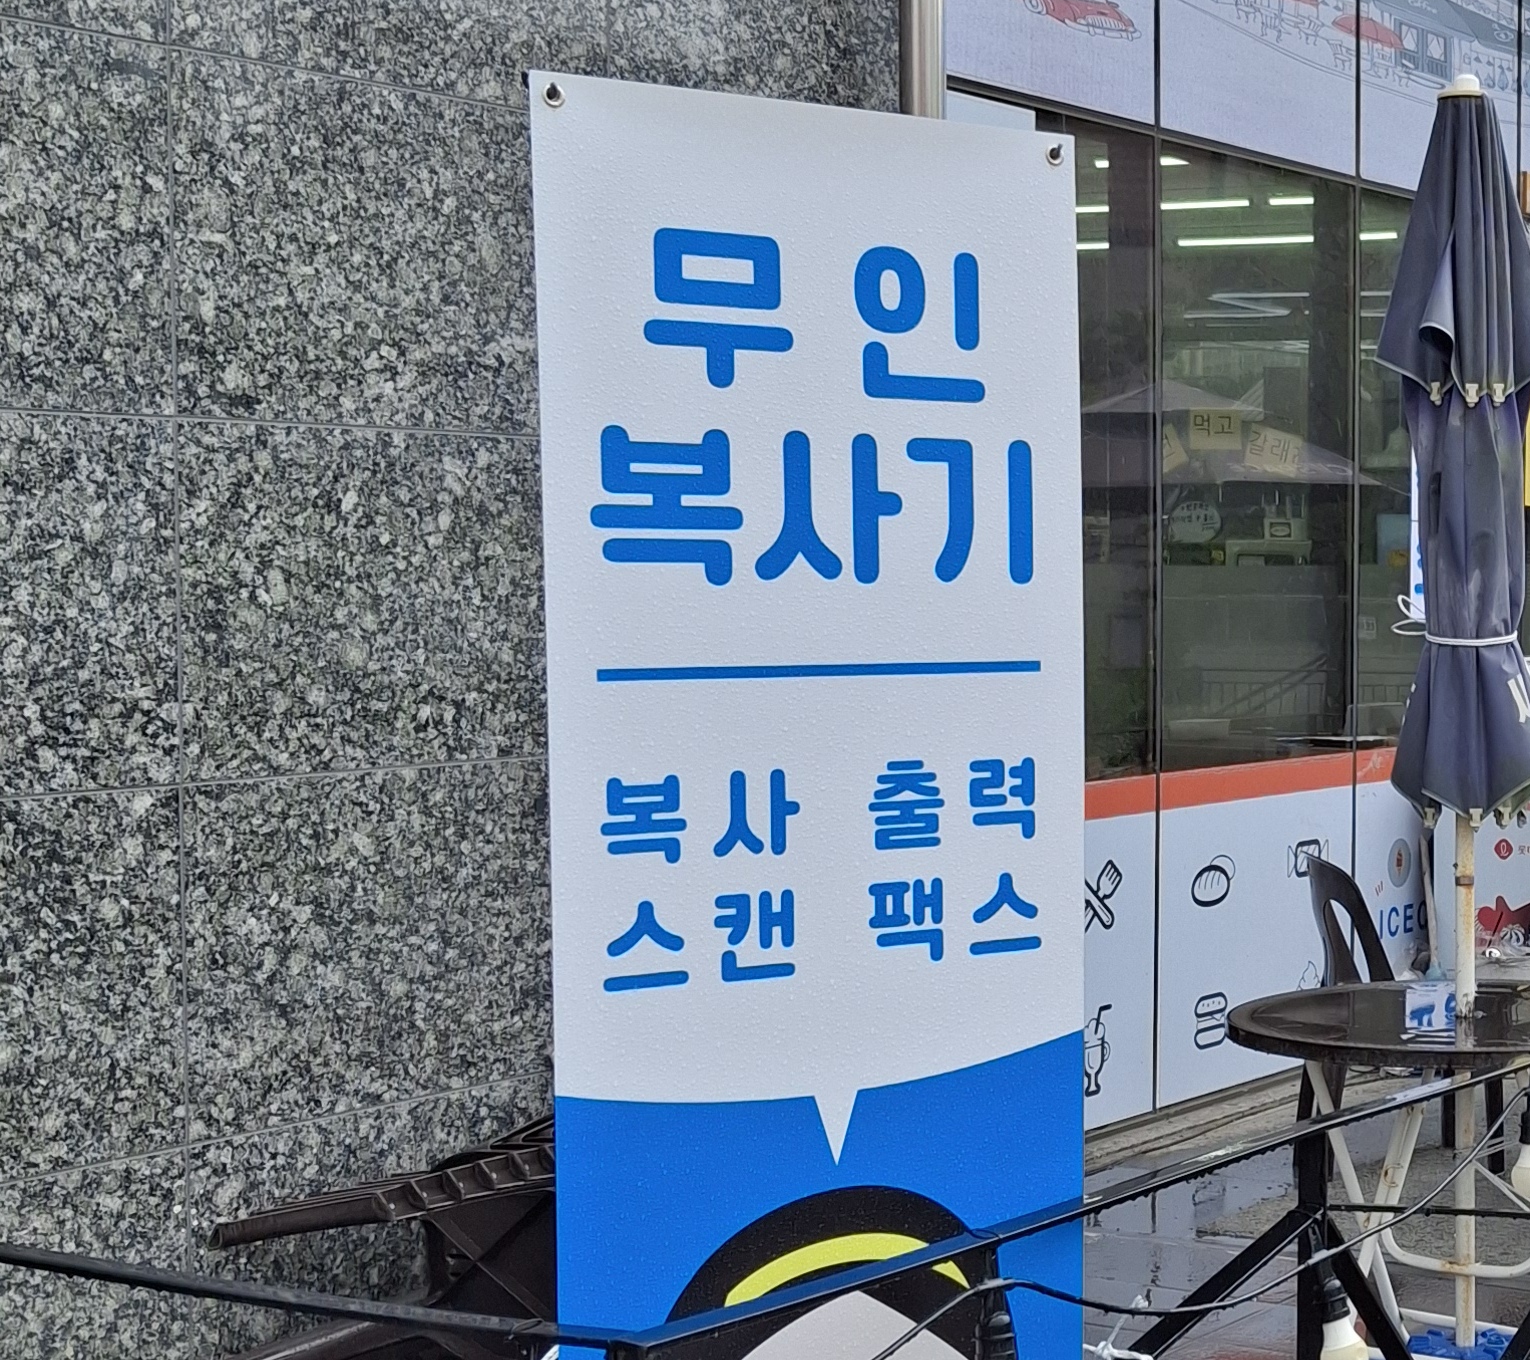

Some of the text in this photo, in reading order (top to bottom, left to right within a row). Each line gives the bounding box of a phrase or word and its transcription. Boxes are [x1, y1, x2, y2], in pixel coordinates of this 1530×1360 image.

[1194, 414, 1234, 437] 먹고
[590, 425, 1034, 585] 복사기
[600, 756, 1038, 864] 복사 출력
[603, 872, 1042, 992] 스캔 팩스
